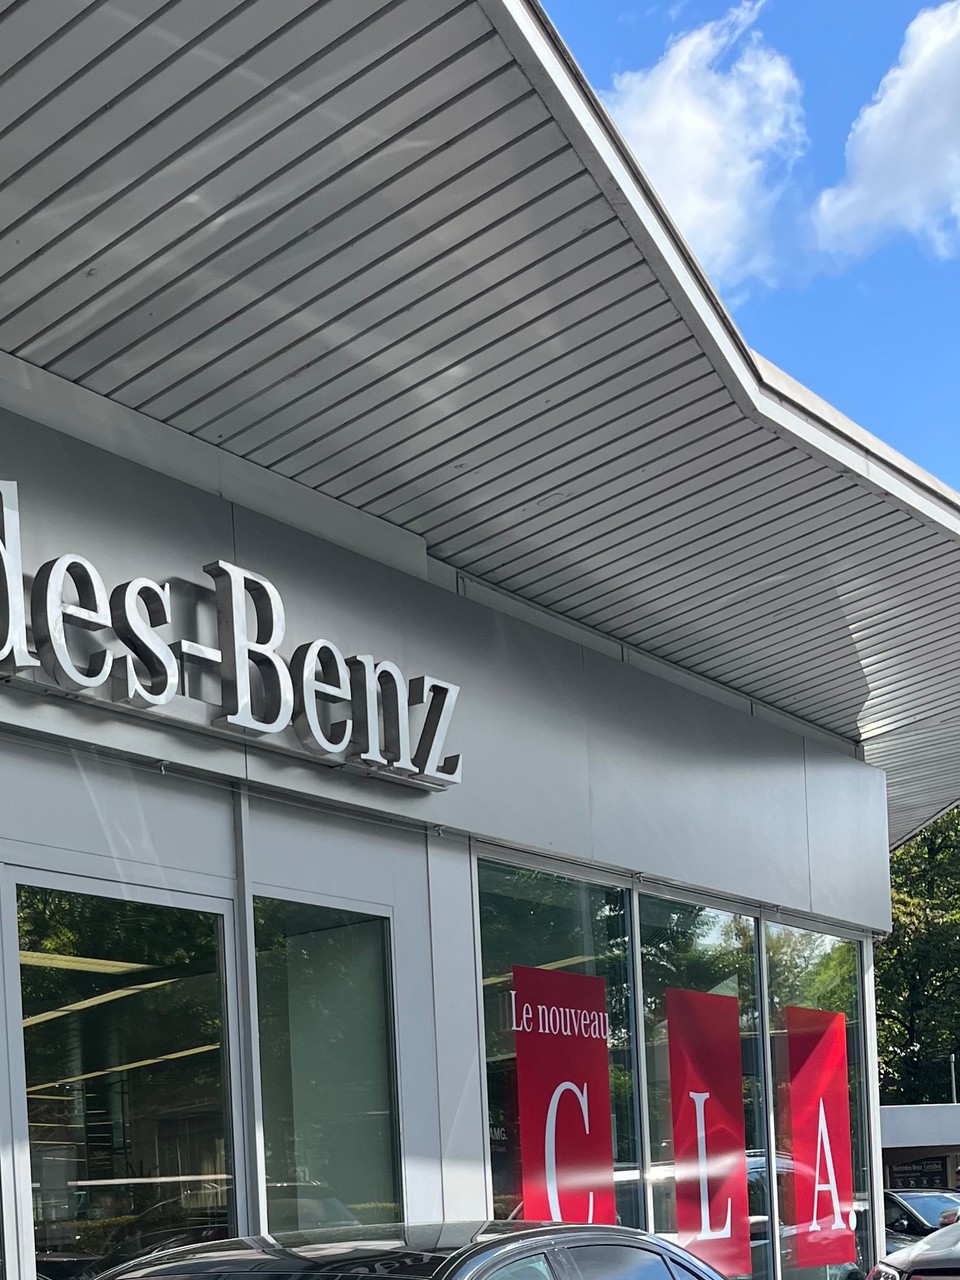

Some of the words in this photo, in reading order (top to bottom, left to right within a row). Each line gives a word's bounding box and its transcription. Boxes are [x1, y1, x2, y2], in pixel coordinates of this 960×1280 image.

[509, 990, 533, 1032] Le
[537, 1004, 609, 1040] nouveau
[545, 1080, 594, 1224] C
[689, 1091, 732, 1241] L
